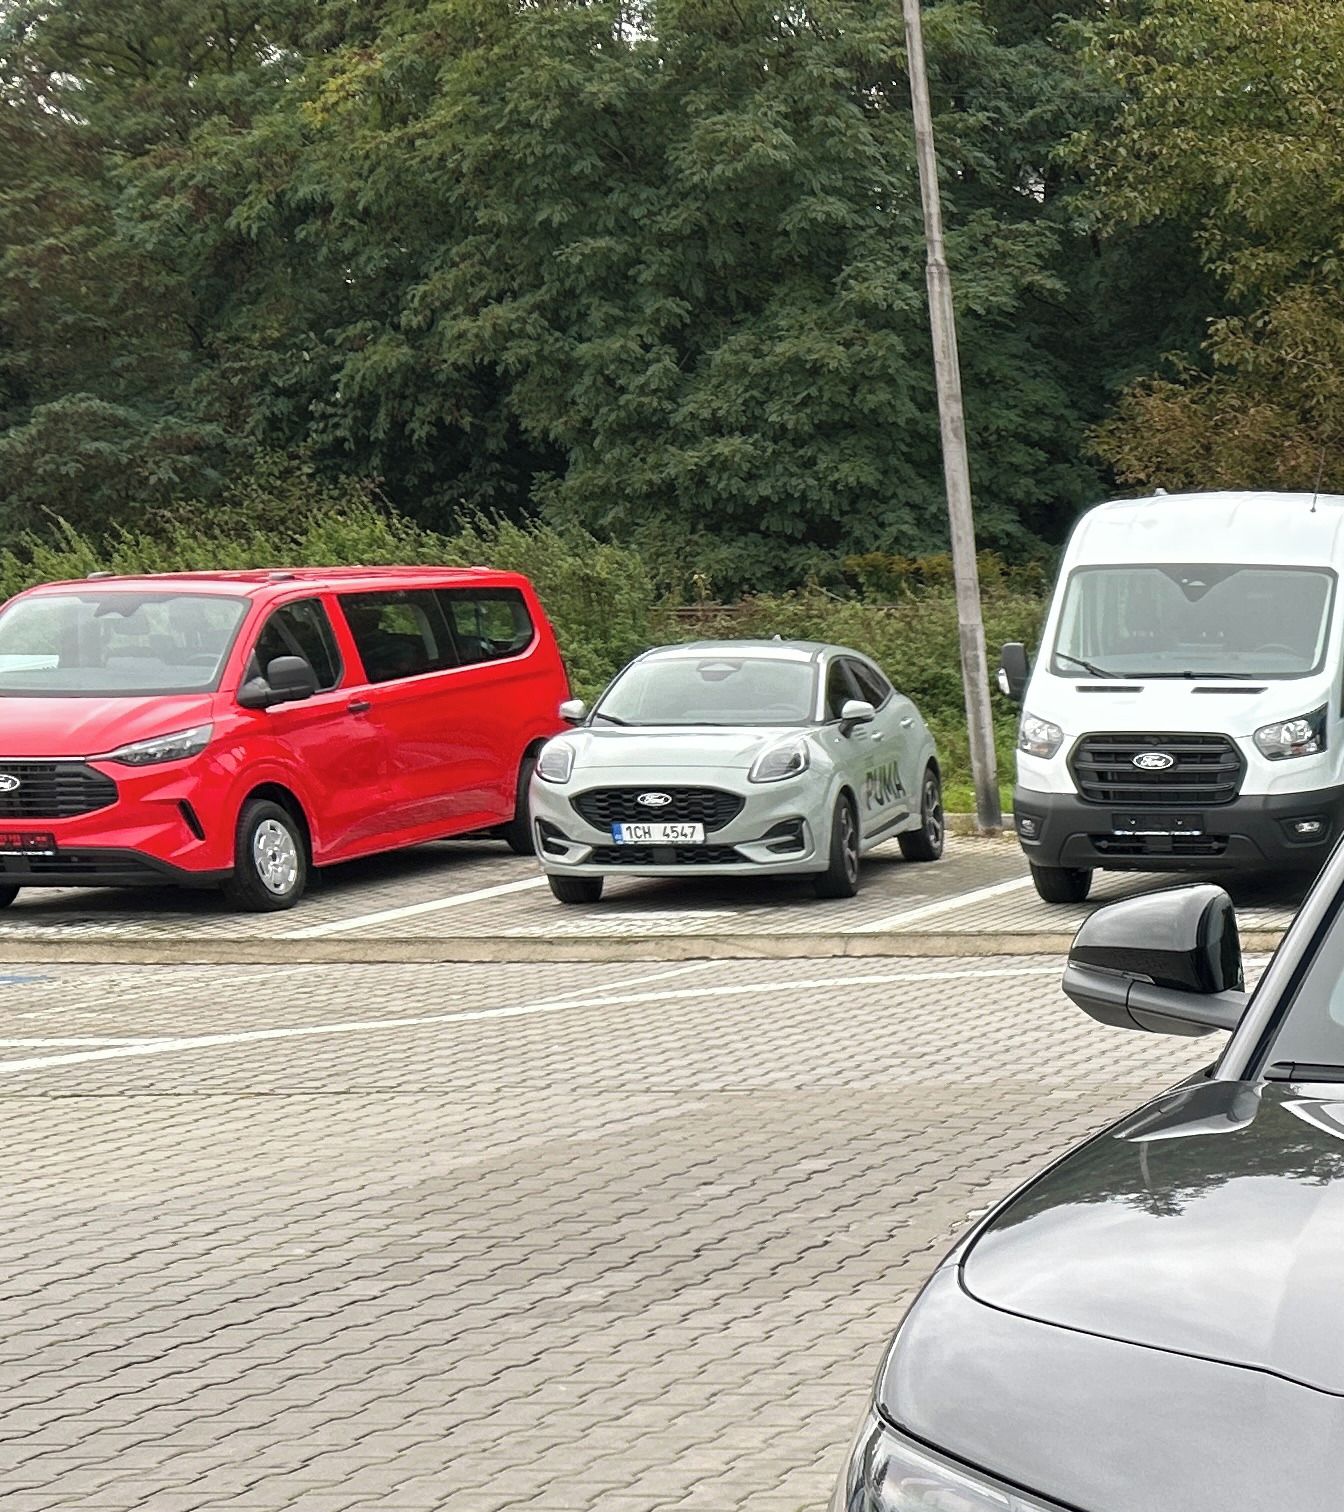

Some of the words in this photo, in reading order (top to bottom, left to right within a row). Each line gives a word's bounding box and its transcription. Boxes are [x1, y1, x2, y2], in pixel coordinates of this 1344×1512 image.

[865, 760, 906, 811] PUMA
[625, 825, 652, 839] 1CH
[662, 825, 697, 839] 4547
